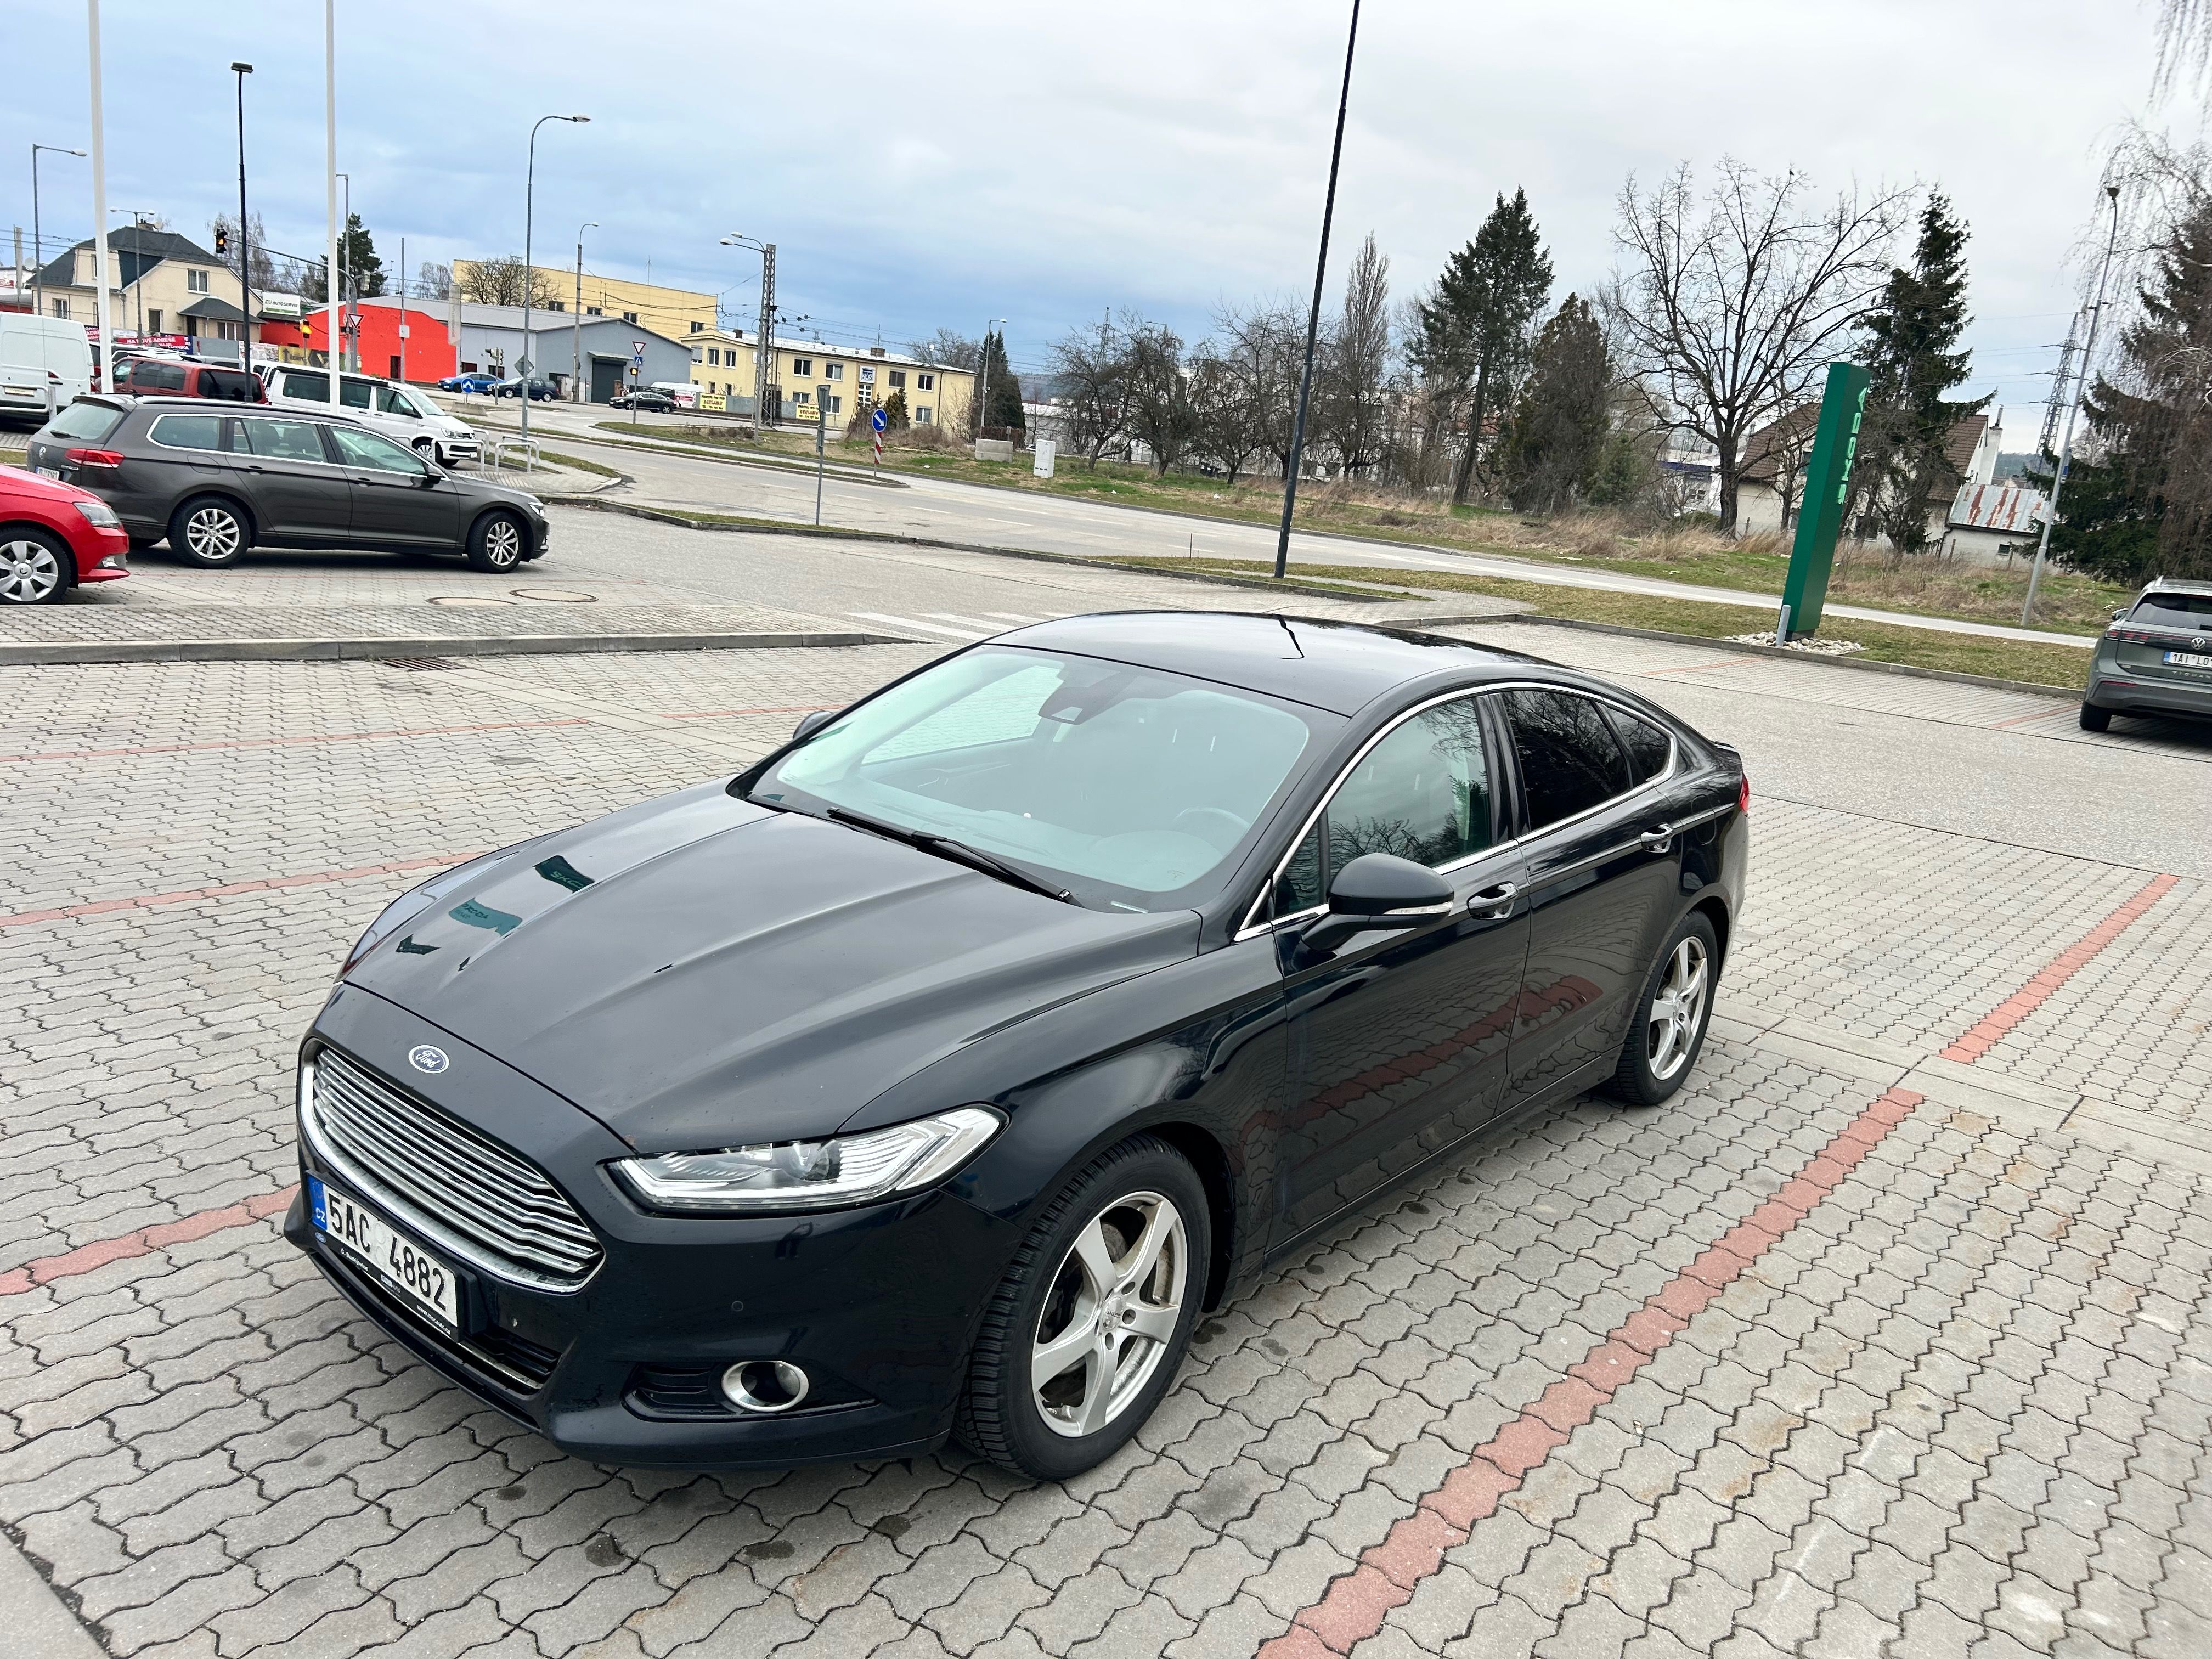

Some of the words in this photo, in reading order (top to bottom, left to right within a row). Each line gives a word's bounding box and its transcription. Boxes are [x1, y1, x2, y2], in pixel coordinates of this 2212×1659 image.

[415, 1049, 441, 1069] Ford
[315, 1207, 326, 1223] CZ
[328, 1193, 371, 1254] 5AC
[390, 1234, 447, 1312] 4882
